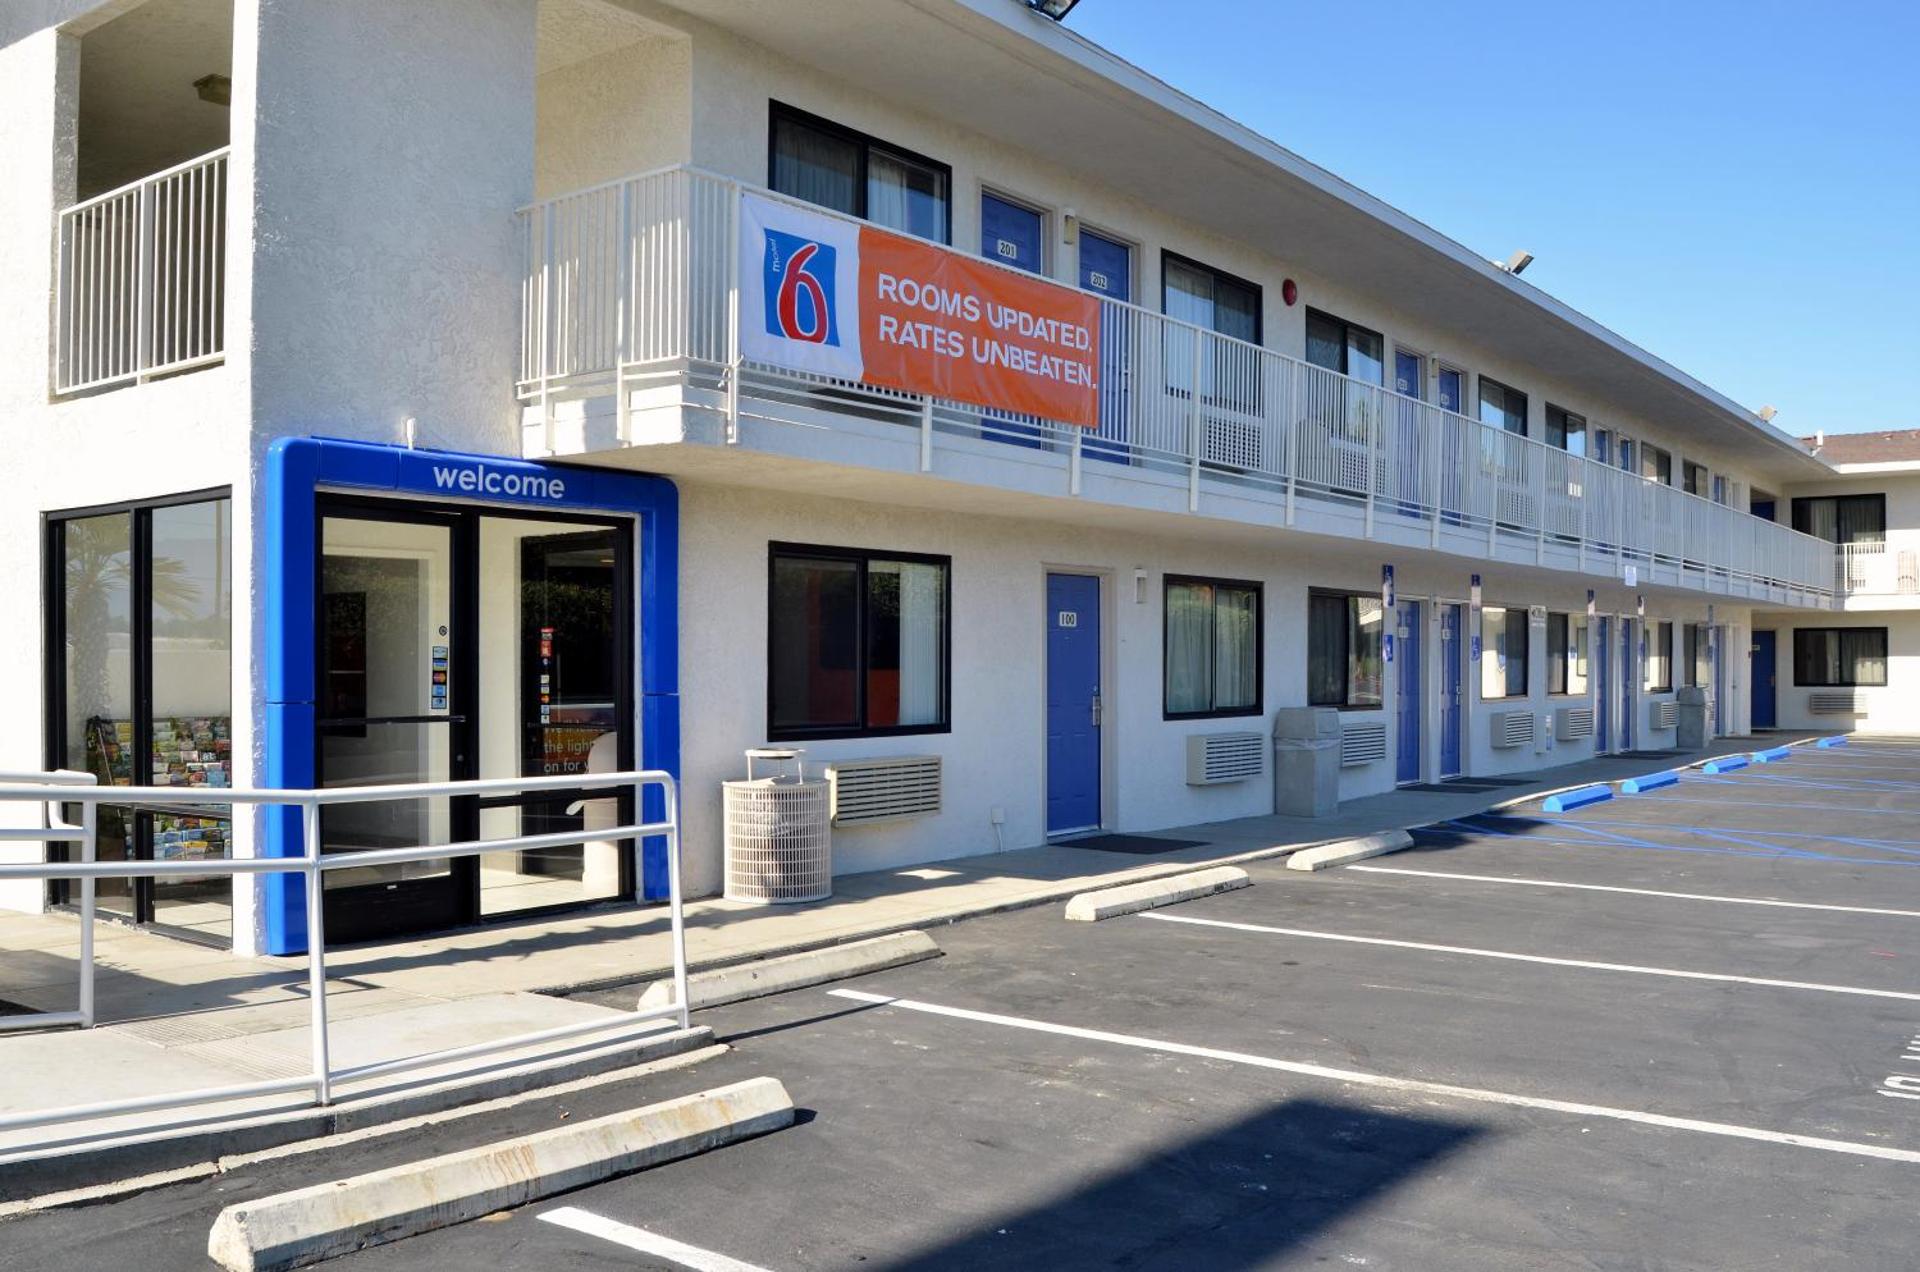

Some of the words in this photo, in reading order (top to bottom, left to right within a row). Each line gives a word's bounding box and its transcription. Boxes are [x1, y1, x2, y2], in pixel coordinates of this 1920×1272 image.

[777, 242, 828, 344] 6
[878, 272, 980, 322] ROOMS
[986, 302, 1092, 352] UPDATED.
[879, 314, 964, 358] RATES
[972, 336, 1097, 389] UNBEATEN.
[433, 464, 565, 499] welcome
[544, 739, 564, 753] the
[544, 763, 559, 773] on
[563, 758, 580, 772] for
